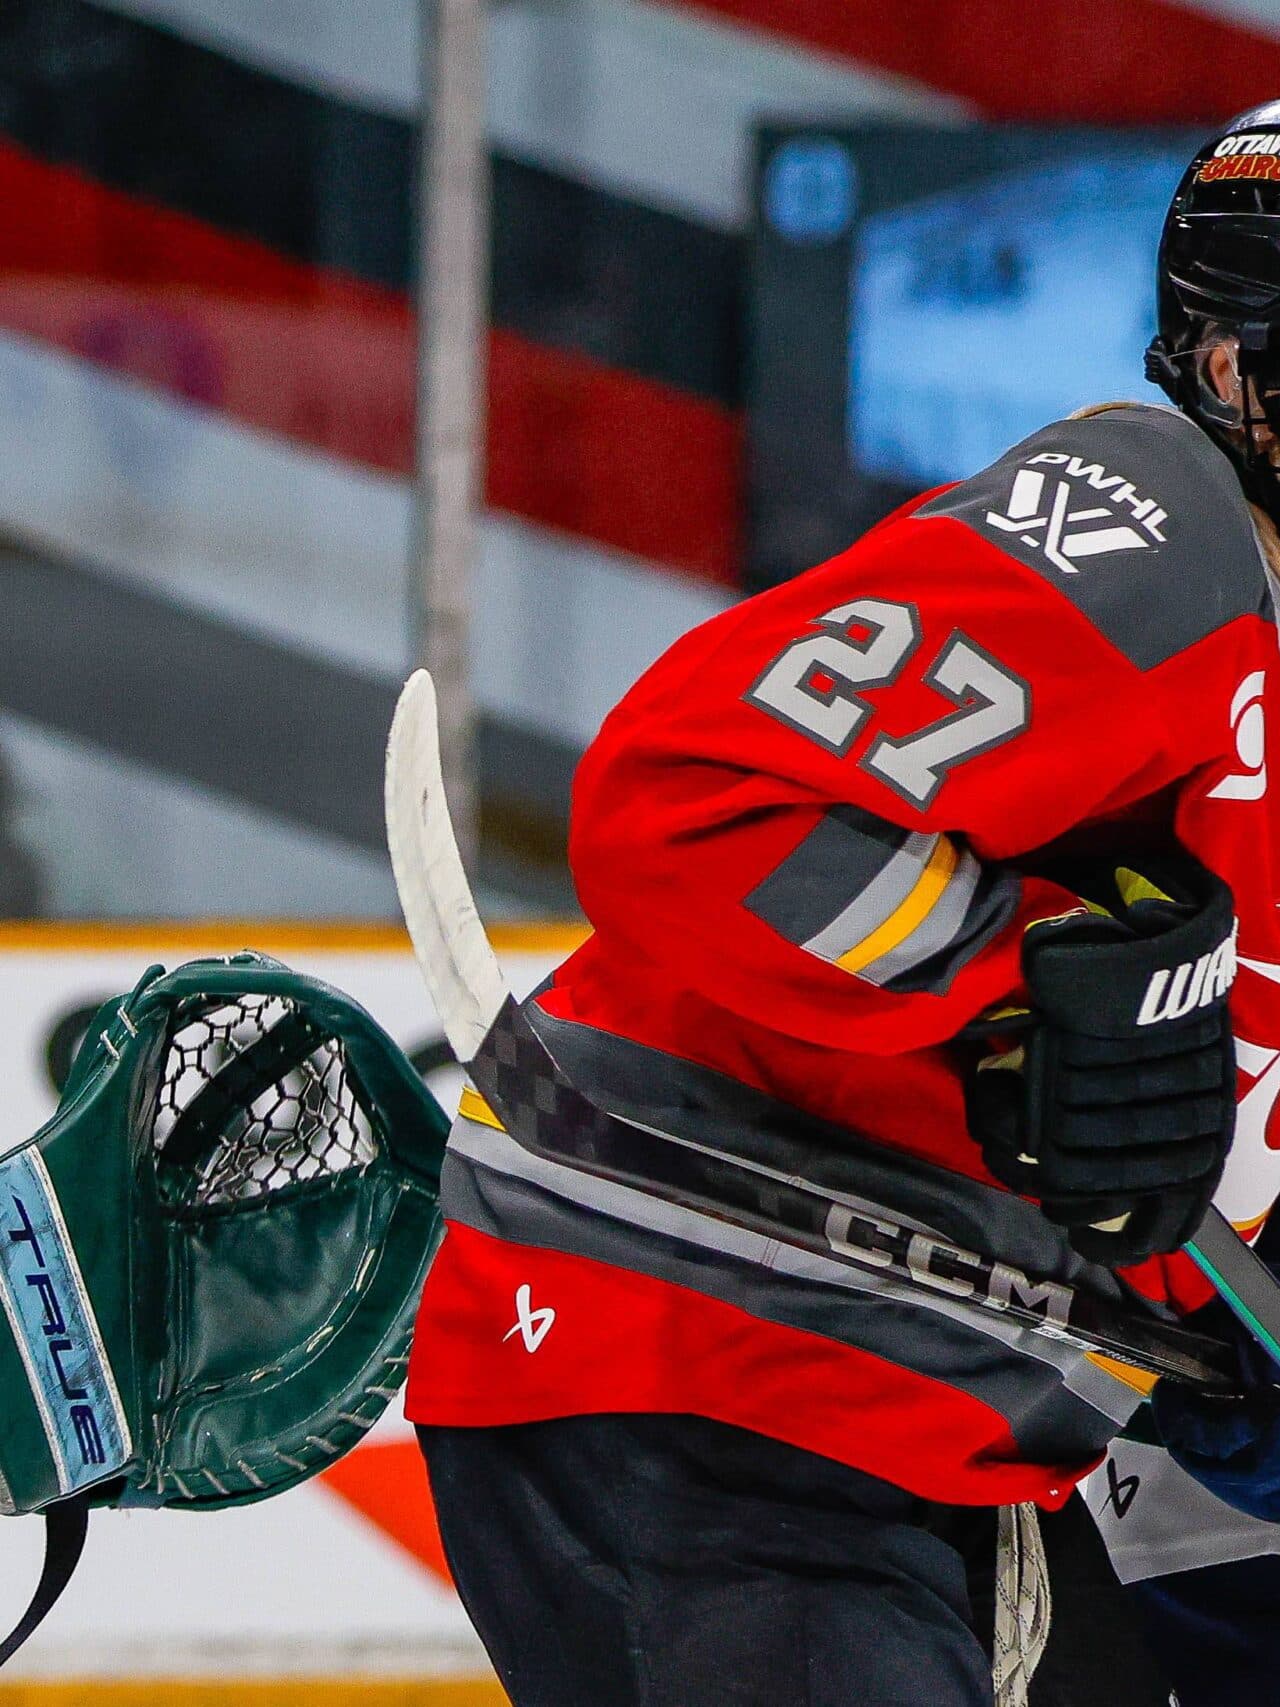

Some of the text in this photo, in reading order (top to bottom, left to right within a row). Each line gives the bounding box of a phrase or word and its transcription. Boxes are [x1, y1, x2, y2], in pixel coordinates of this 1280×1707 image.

[1026, 452, 1169, 542] PWHL
[740, 597, 1033, 813] 27
[12, 1198, 104, 1467] TRUE
[826, 1202, 1075, 1330] CCM
